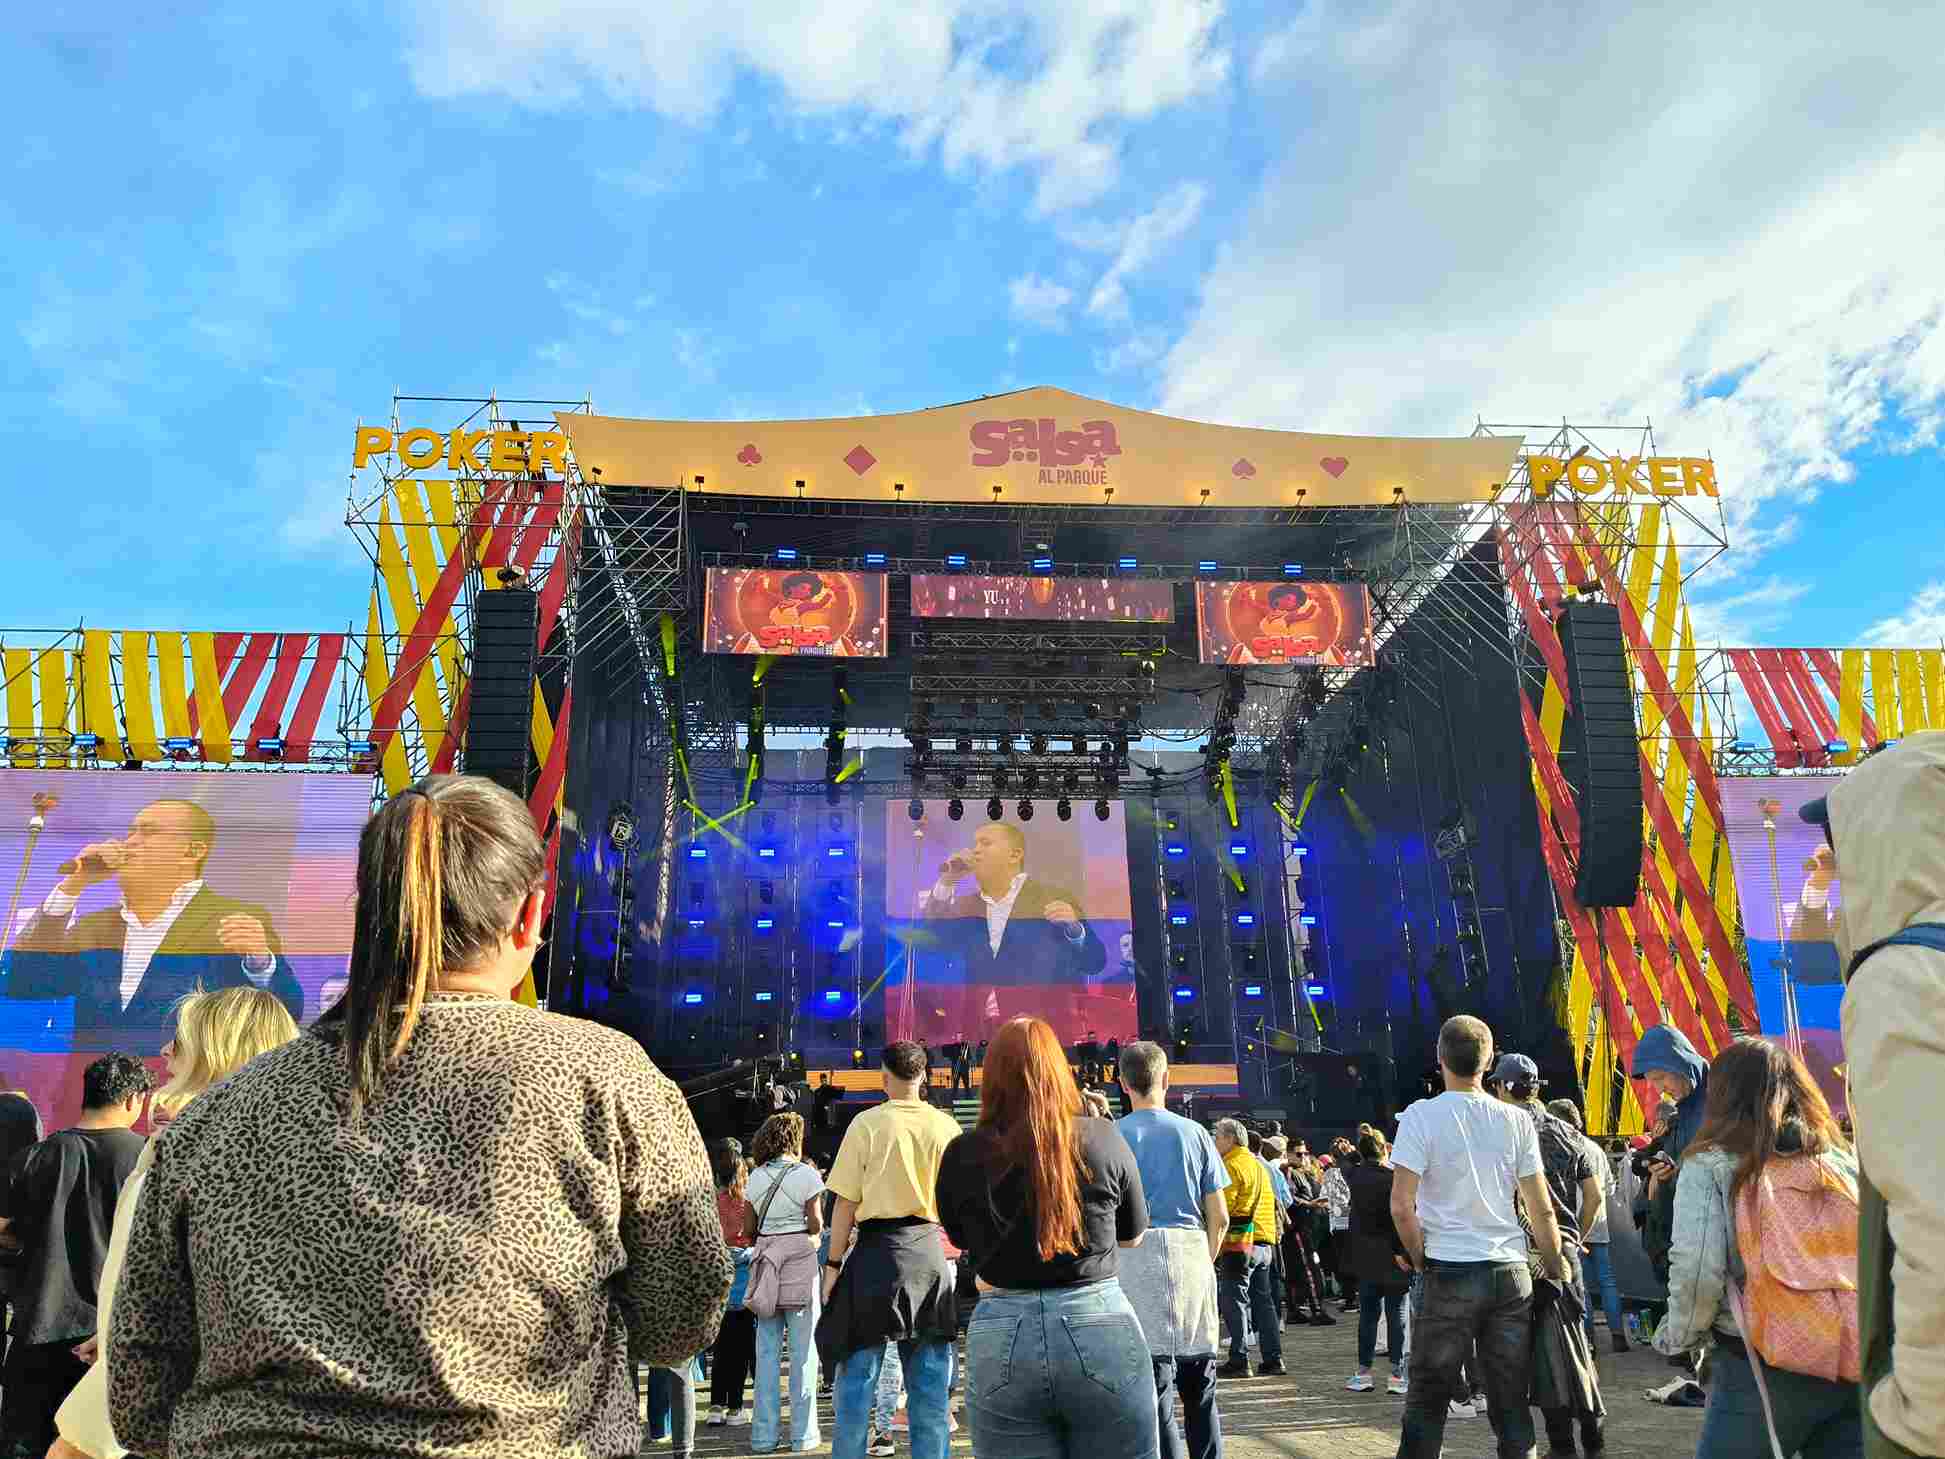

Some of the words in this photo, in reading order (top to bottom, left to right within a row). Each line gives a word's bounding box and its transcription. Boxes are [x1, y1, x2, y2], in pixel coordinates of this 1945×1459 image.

[353, 427, 569, 473] POKER
[1038, 469, 1055, 485] AL
[1057, 470, 1107, 486] PARQUE
[1528, 455, 1720, 497] POKER
